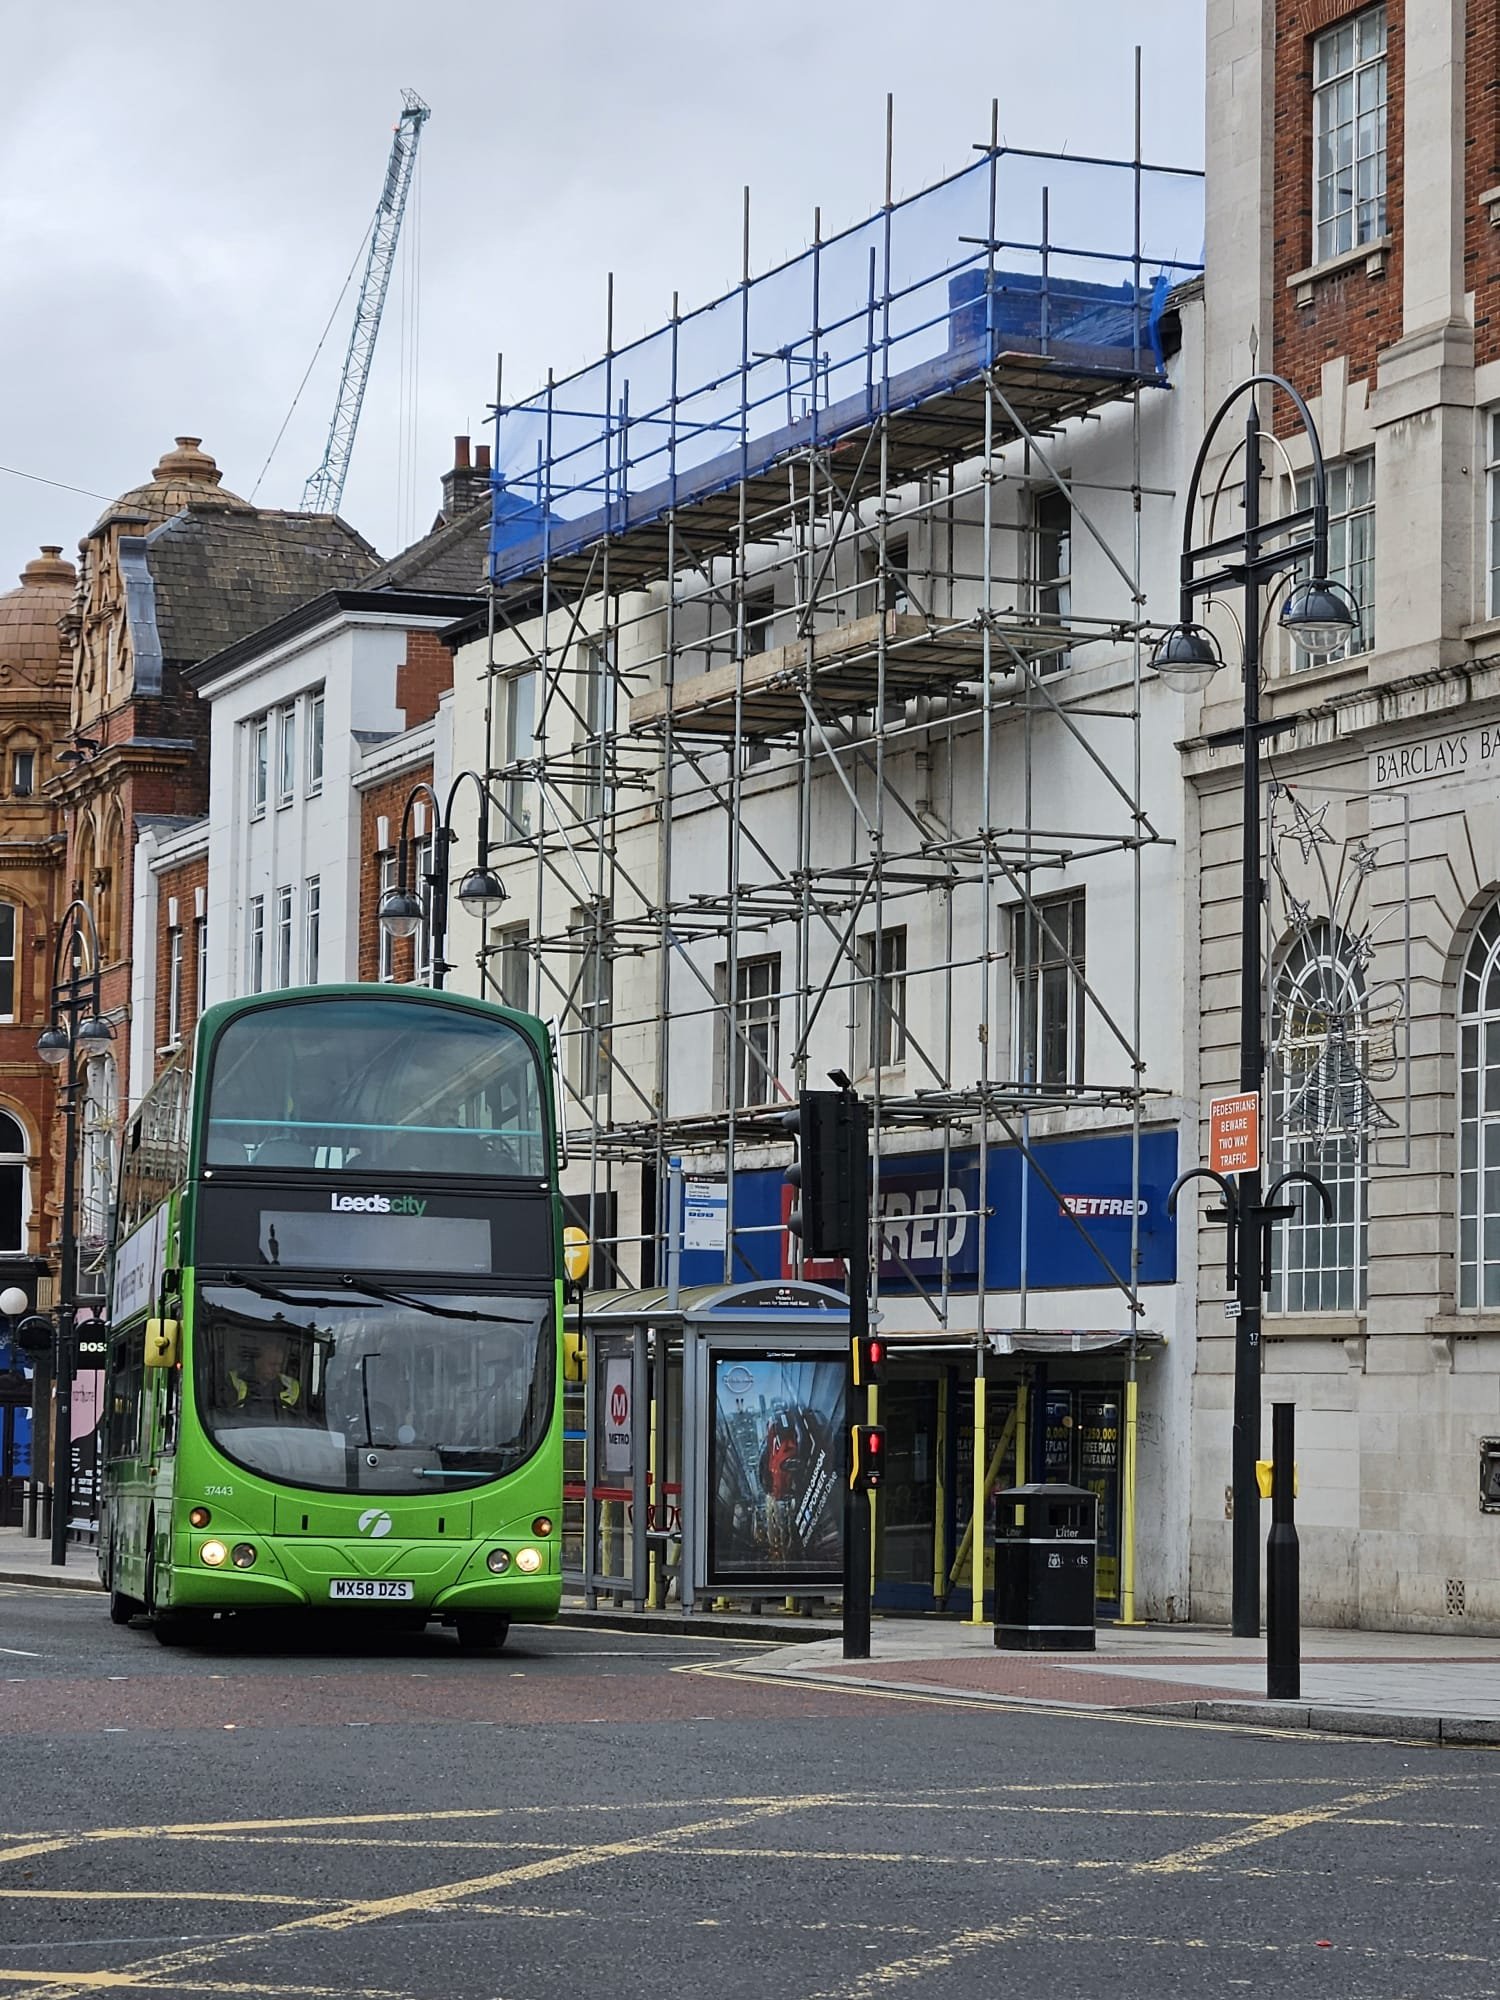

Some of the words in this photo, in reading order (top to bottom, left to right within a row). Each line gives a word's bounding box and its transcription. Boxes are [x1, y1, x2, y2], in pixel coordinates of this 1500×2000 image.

[1377, 736, 1468, 783] BARCLAYS
[1212, 1099, 1256, 1117] PEDESTRIANS
[1221, 1118, 1248, 1133] BEWARE
[1218, 1137, 1233, 1150] TWO
[1234, 1135, 1248, 1147] WAY
[1220, 1152, 1247, 1166] TRAFFIC
[1062, 1198, 1148, 1216] BETFRED
[613, 1393, 626, 1416] M
[609, 1434, 629, 1445] METRO
[204, 1486, 233, 1496] 37443
[1055, 1525, 1079, 1538] Litter
[336, 1582, 374, 1597] MX58
[378, 1583, 407, 1597] DZS
